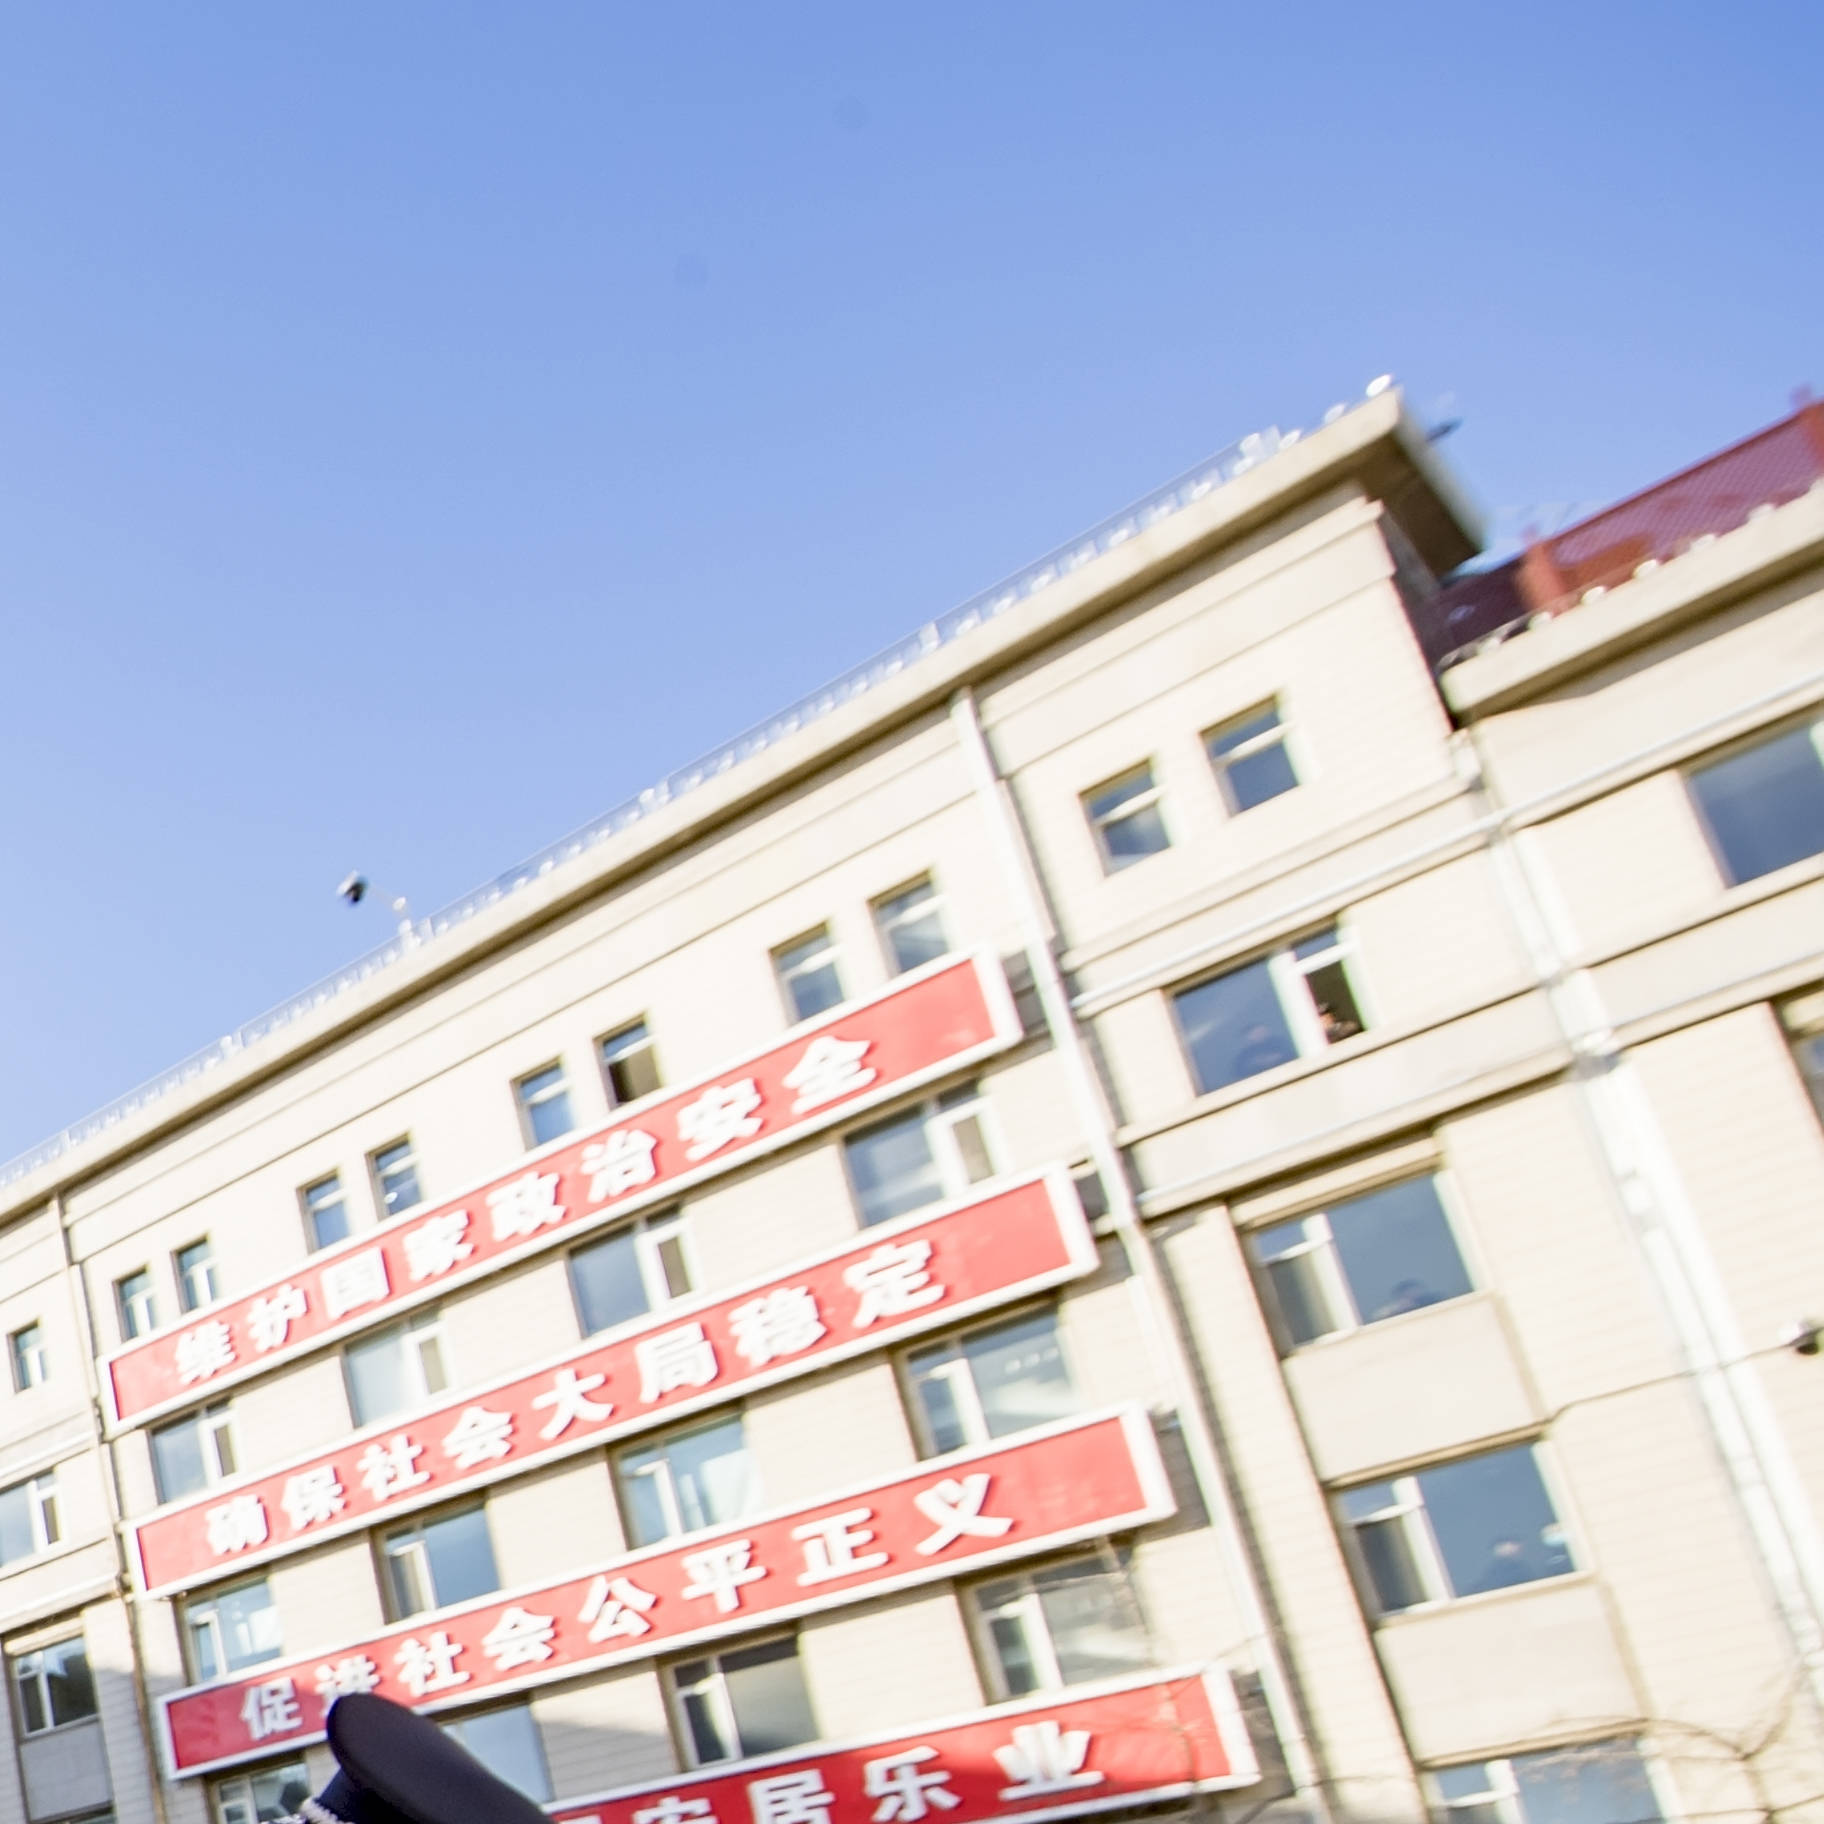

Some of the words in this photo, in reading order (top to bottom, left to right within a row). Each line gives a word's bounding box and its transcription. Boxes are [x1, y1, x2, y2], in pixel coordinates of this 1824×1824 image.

[175, 1036, 876, 1385] 维护国家政治安全
[205, 1239, 945, 1556] 确保社会大局稳定
[240, 1473, 1013, 1741] 促进社会公平正义
